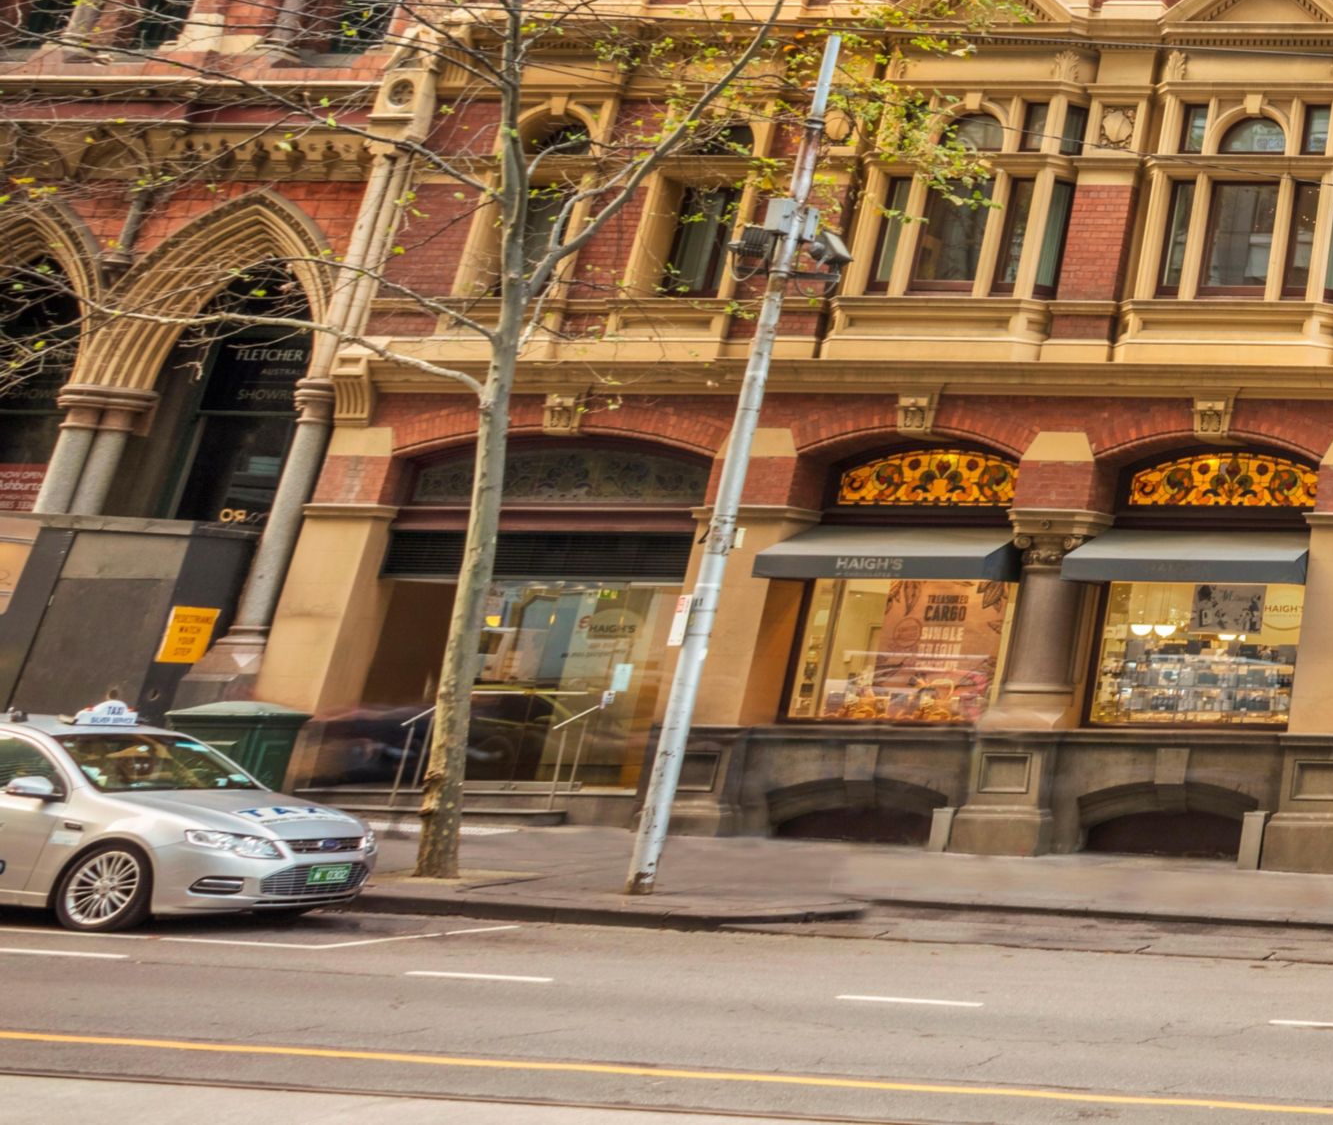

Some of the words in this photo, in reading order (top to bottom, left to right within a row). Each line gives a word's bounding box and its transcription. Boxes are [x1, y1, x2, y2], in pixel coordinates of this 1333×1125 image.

[235, 348, 304, 362] FLETCHER
[835, 557, 905, 571] HAIGH'S
[927, 594, 969, 605] TREASURED
[924, 606, 967, 622] CARGO
[590, 625, 636, 634] HAIGH'S
[921, 627, 964, 641] SINGLE
[107, 706, 126, 716] TAXI
